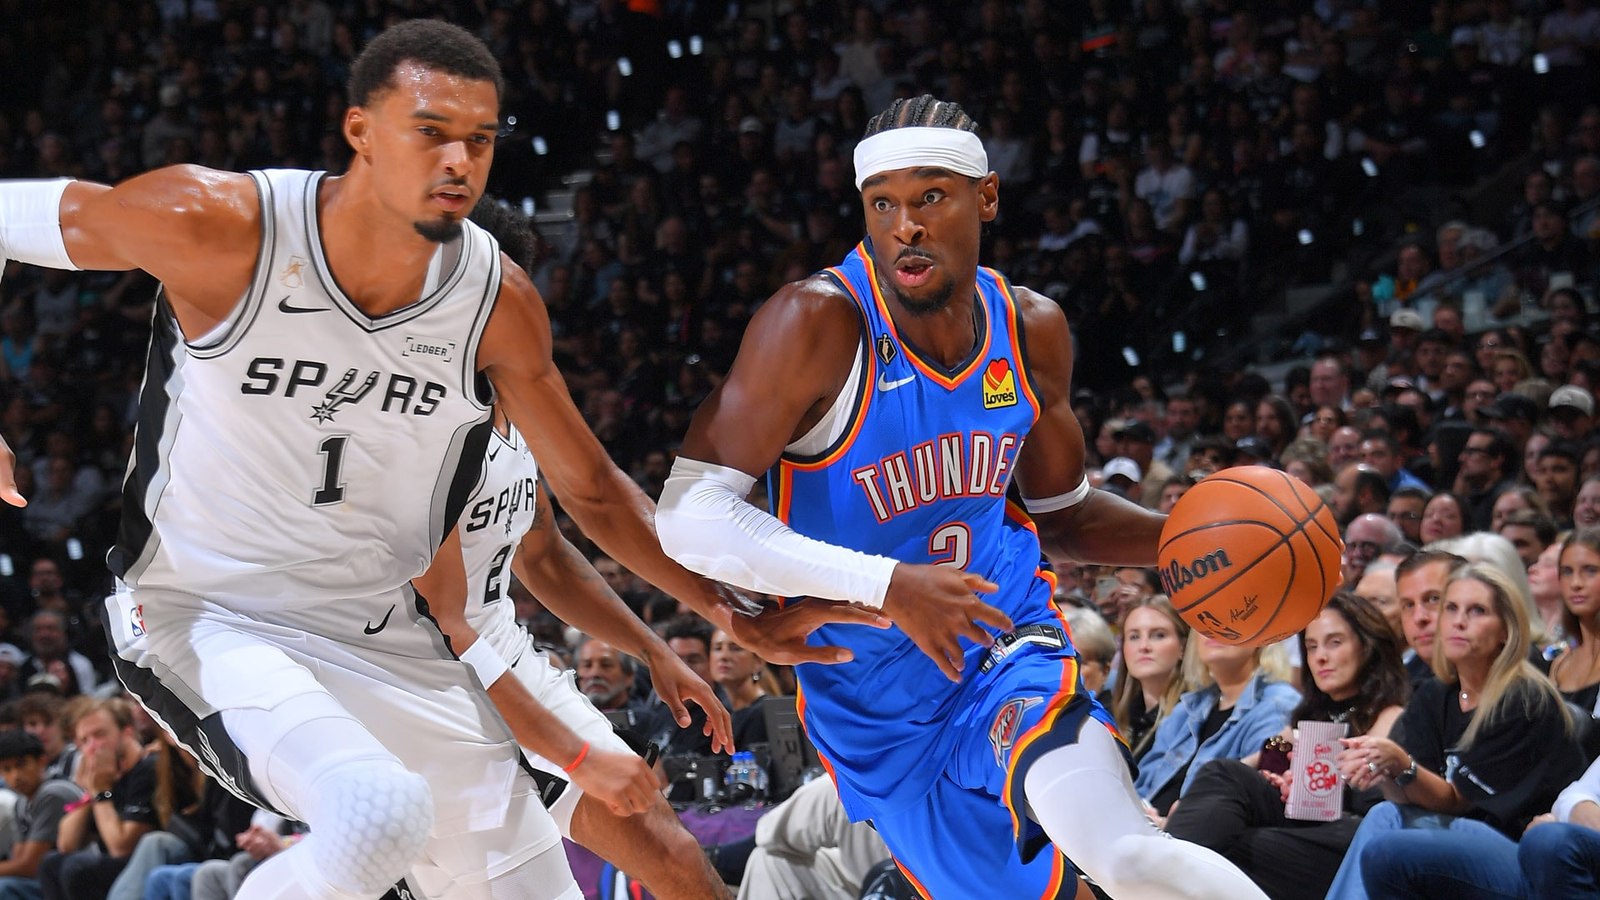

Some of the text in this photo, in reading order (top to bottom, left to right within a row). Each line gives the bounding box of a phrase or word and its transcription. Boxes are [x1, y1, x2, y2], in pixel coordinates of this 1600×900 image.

[410, 344, 448, 357] LEDGER
[241, 357, 447, 424] SPURS
[312, 433, 350, 507] 1
[852, 431, 1025, 524] THUNDE
[466, 478, 538, 537] SPUR
[482, 541, 513, 608] 2
